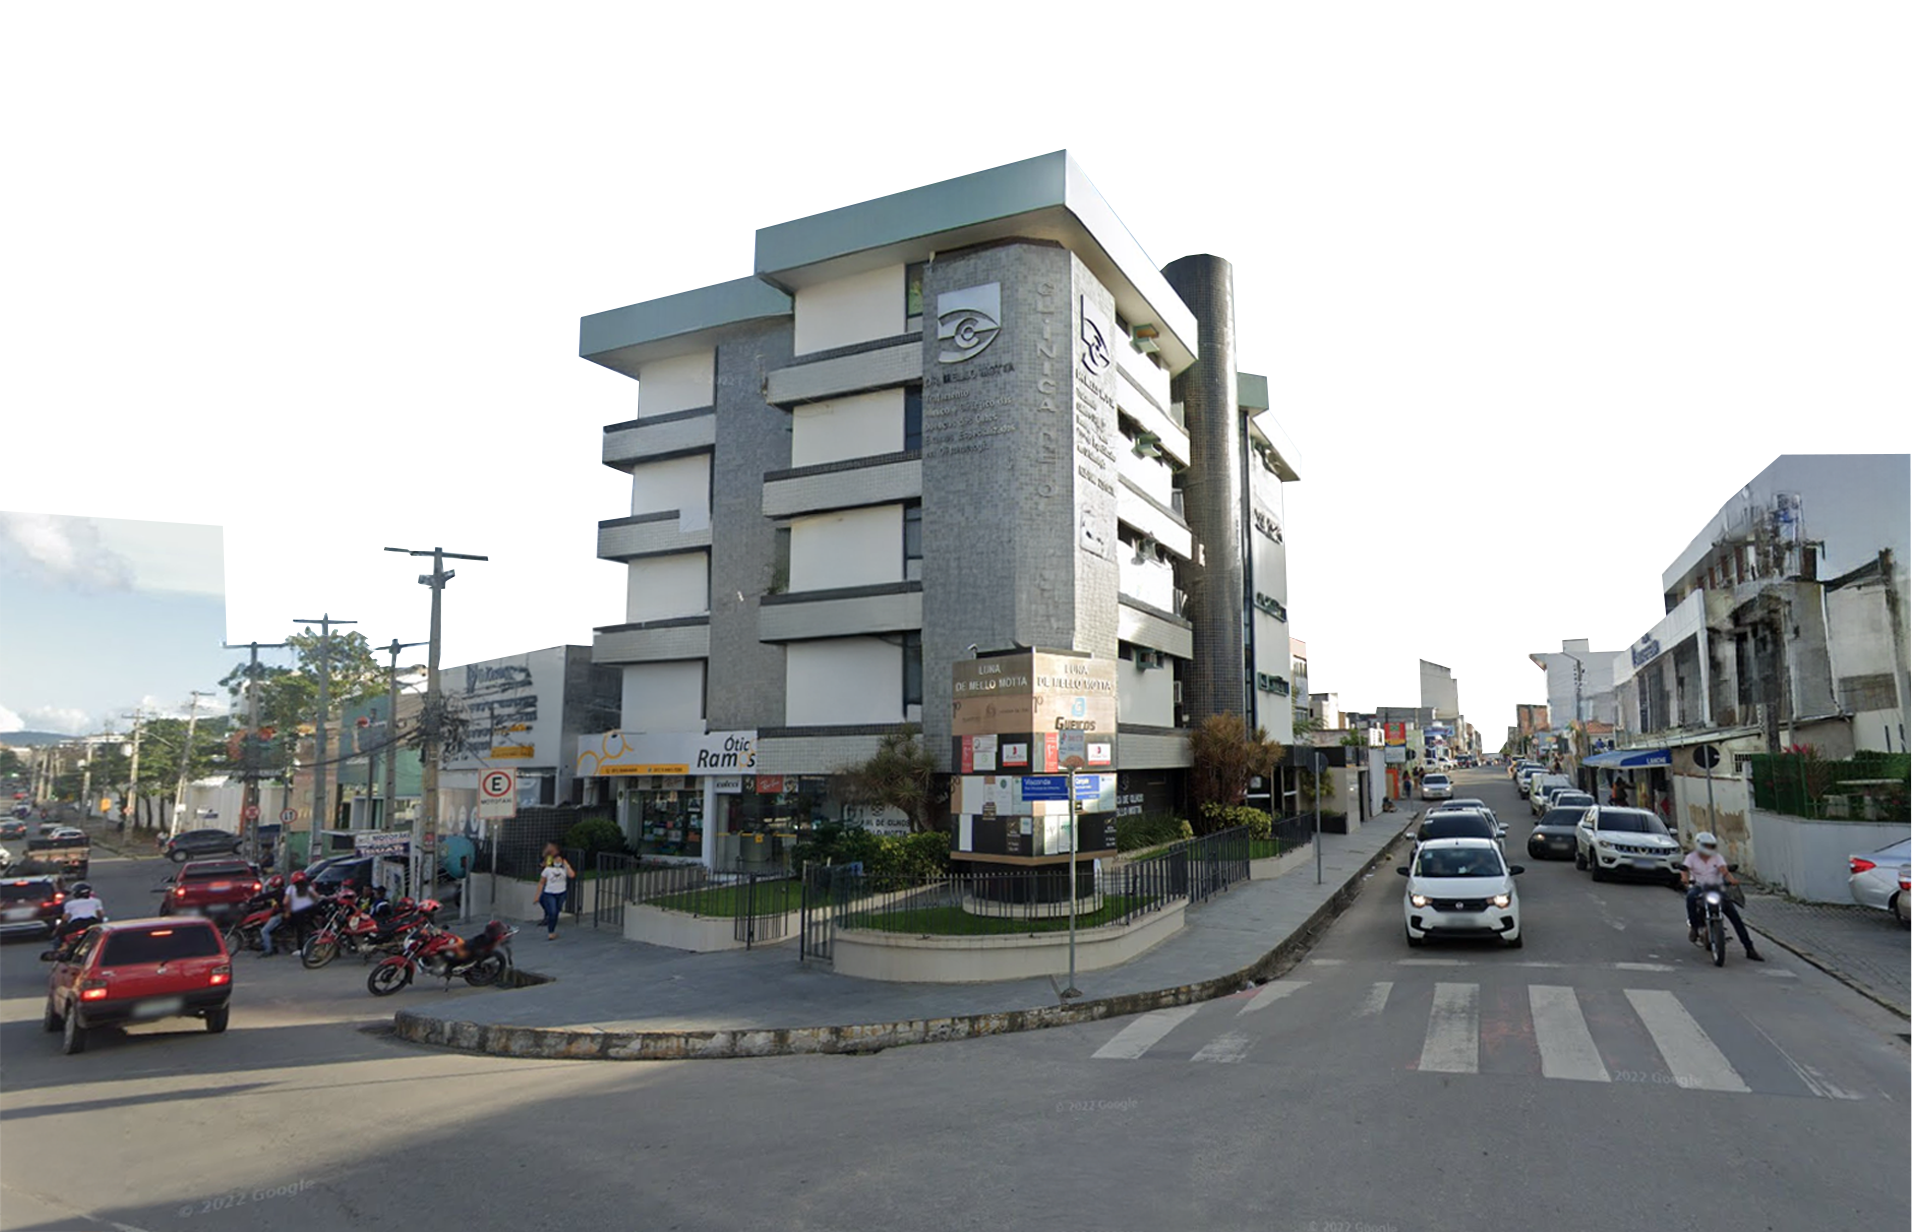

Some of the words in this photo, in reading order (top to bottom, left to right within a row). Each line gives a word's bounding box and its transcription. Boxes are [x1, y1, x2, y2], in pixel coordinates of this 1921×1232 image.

[955, 681, 967, 692] DE
[969, 679, 997, 691] MELLO
[998, 676, 1028, 688] MOTTA
[492, 776, 502, 791] E
